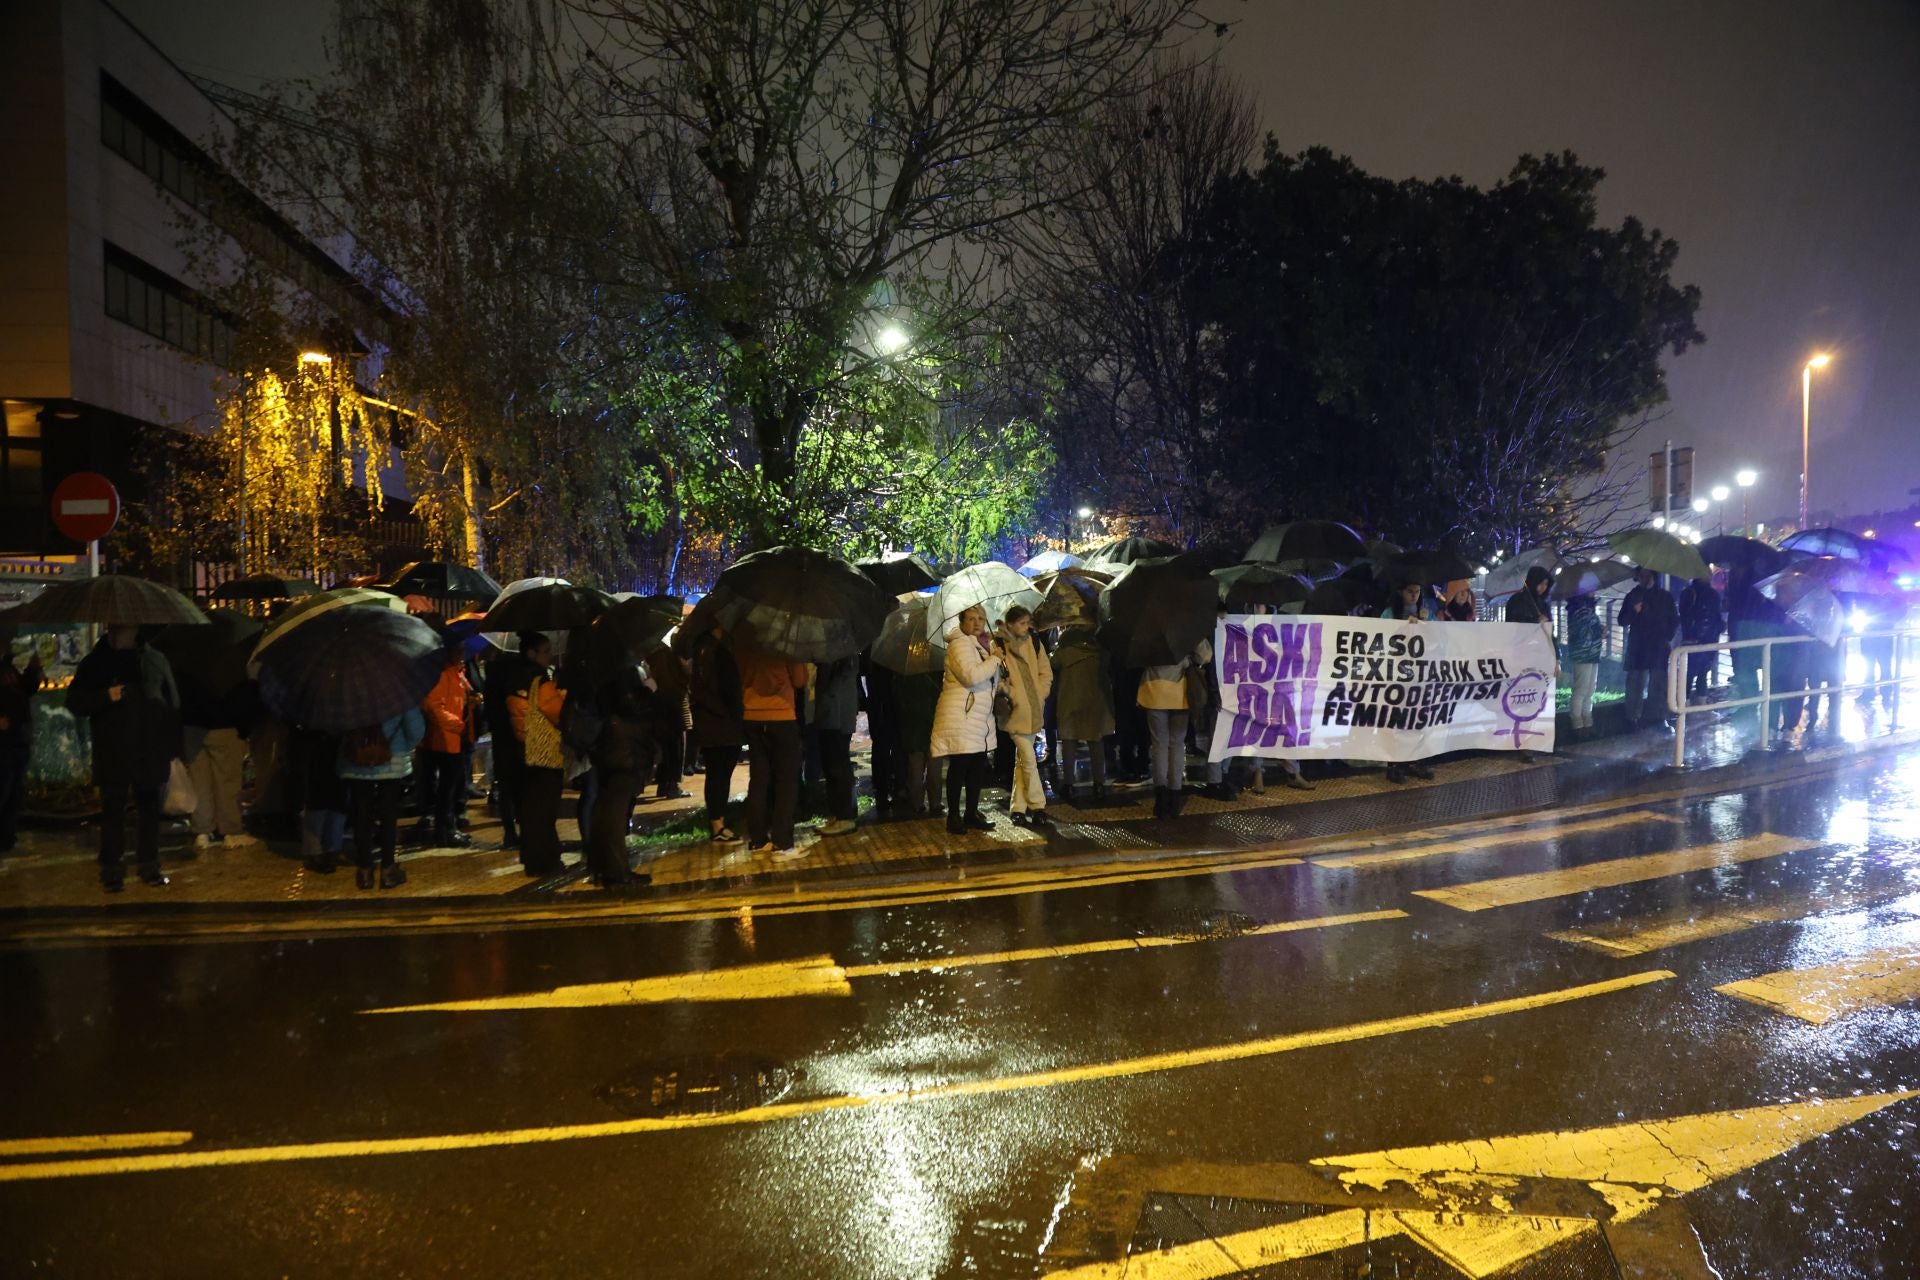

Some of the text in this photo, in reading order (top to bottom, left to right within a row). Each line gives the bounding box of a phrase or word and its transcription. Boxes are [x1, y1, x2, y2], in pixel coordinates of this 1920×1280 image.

[1223, 623, 1323, 684] ASKI
[1336, 631, 1425, 658] ERASO
[1331, 656, 1474, 683] SEXISTARIK
[1477, 659, 1510, 679] EZ!
[1327, 681, 1501, 707] AUTODEFENTSA
[1228, 680, 1318, 748] DA!
[1322, 701, 1457, 730] FEMINISTA!
